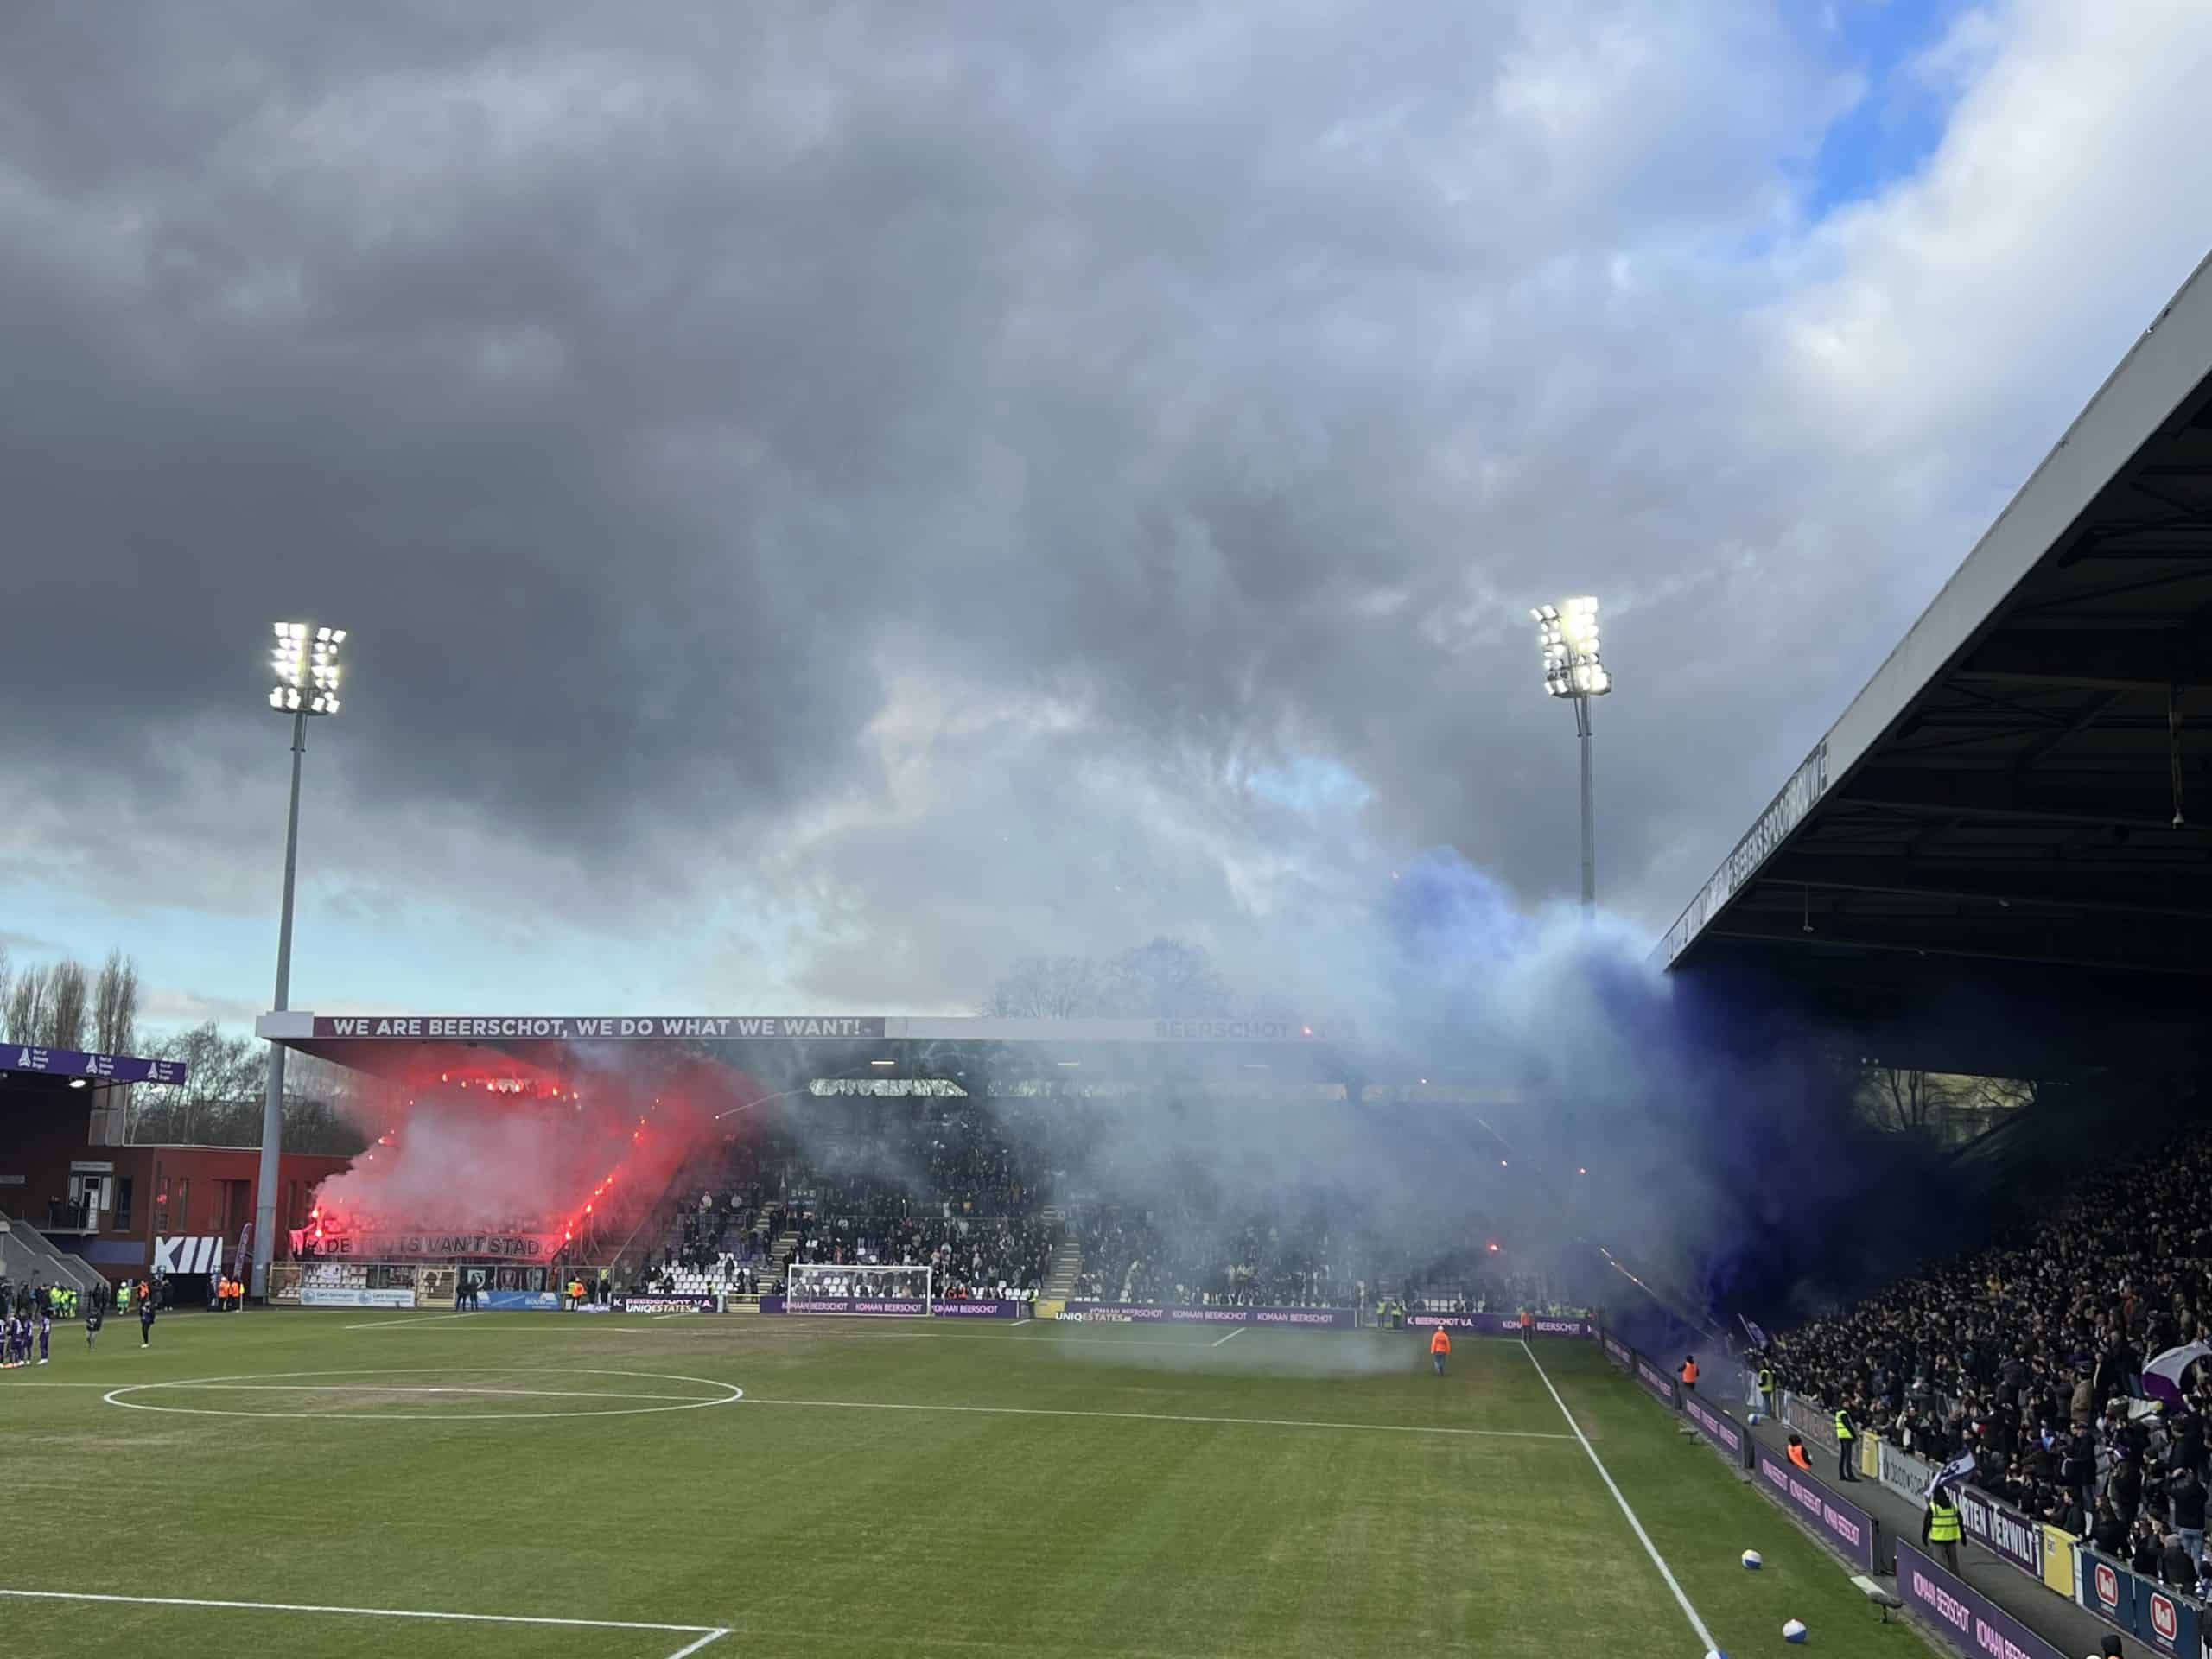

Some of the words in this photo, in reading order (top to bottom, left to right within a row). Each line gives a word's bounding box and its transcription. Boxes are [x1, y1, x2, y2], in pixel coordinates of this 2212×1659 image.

[334, 1020, 369, 1035] WE
[376, 1020, 421, 1035] ARE
[429, 1020, 568, 1039] BEERSCHOT,
[576, 1020, 613, 1035] WE
[620, 1020, 652, 1035] DO
[662, 1020, 730, 1035] WHAT
[738, 1020, 775, 1035] WE
[783, 1020, 860, 1035] WANT!
[327, 1239, 352, 1253] DE
[489, 1239, 539, 1255] STAD
[810, 1302, 848, 1311] BEERSCHOT
[884, 1304, 922, 1313] BEERSCHOT
[960, 1305, 998, 1313] BEERSCHOT
[1173, 1310, 1204, 1319] KOMAAN
[1205, 1311, 1247, 1320] BEERSCHOT
[1257, 1313, 1288, 1321] KOMAAN
[1290, 1313, 1333, 1323] BEERSCHOT
[1415, 1318, 1459, 1326] BEERSCHOT
[1536, 1322, 1580, 1332] BEERSCHOT
[1987, 1500, 2033, 1565] VERWILT
